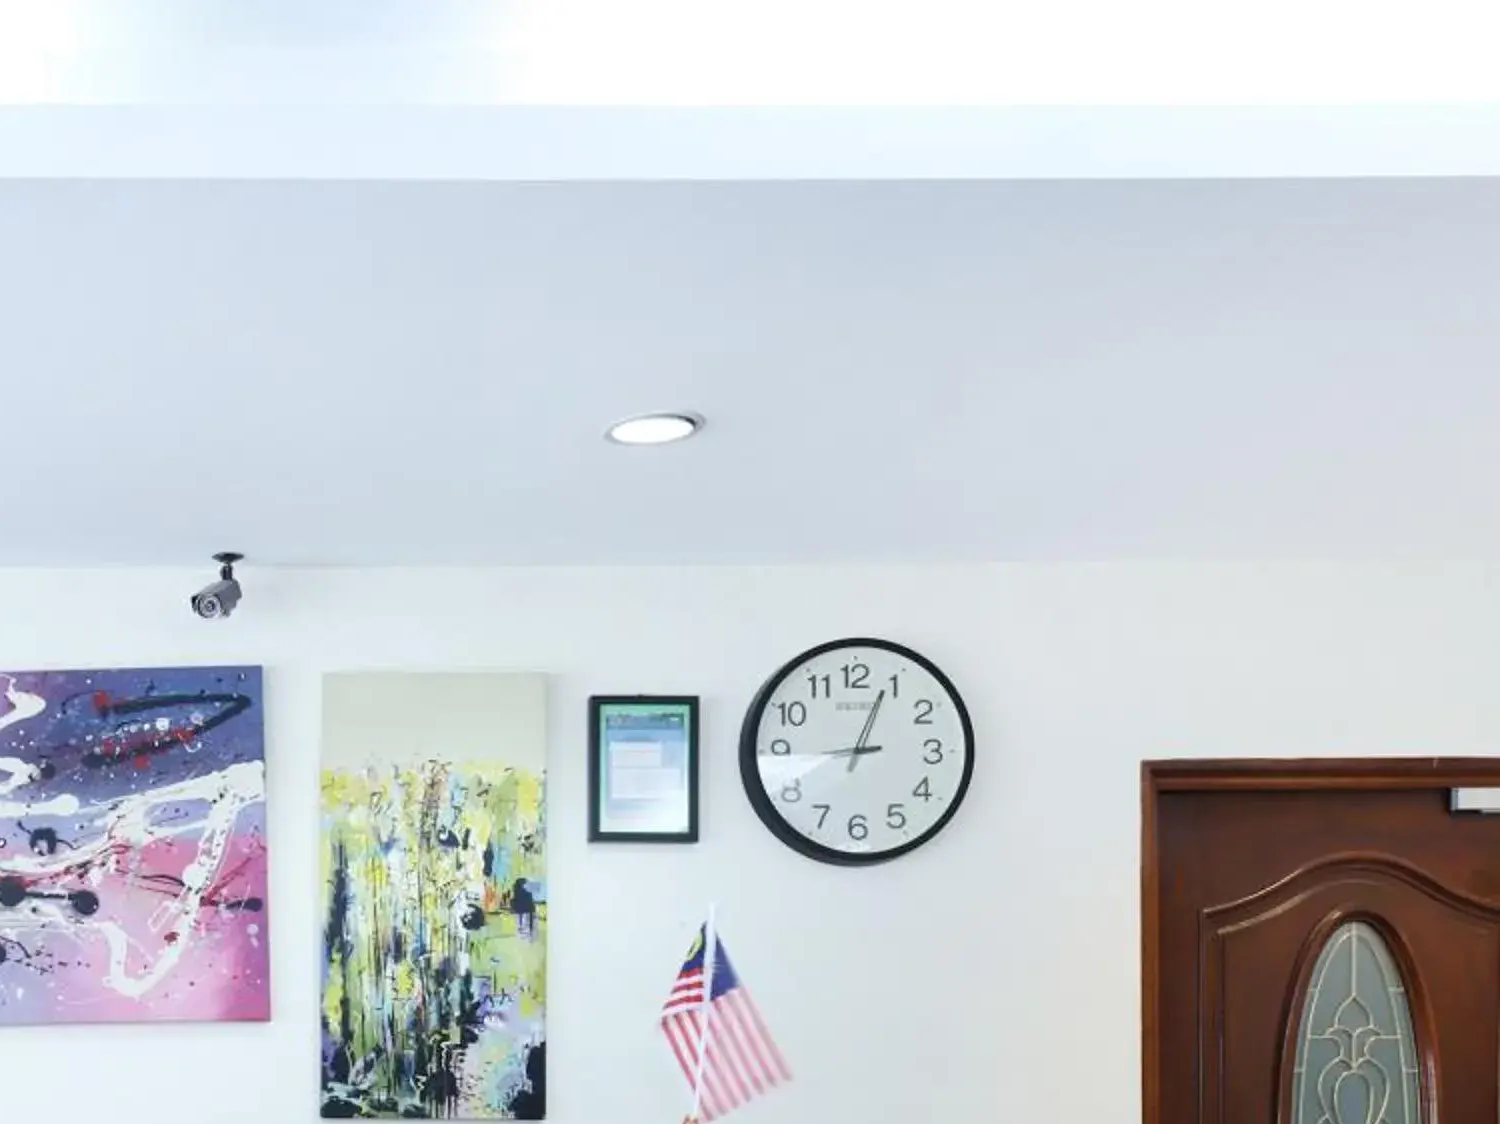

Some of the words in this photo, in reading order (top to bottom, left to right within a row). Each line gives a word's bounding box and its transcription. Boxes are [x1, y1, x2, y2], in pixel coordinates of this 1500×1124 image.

[807, 674, 831, 699] 11
[840, 664, 871, 689] 12
[888, 674, 899, 699] 1
[777, 701, 807, 727] 10
[913, 699, 934, 725] 2
[922, 738, 944, 765] 3
[912, 775, 933, 802] 4
[812, 804, 832, 829] 7
[847, 814, 869, 841] 6
[885, 803, 906, 829] 5
